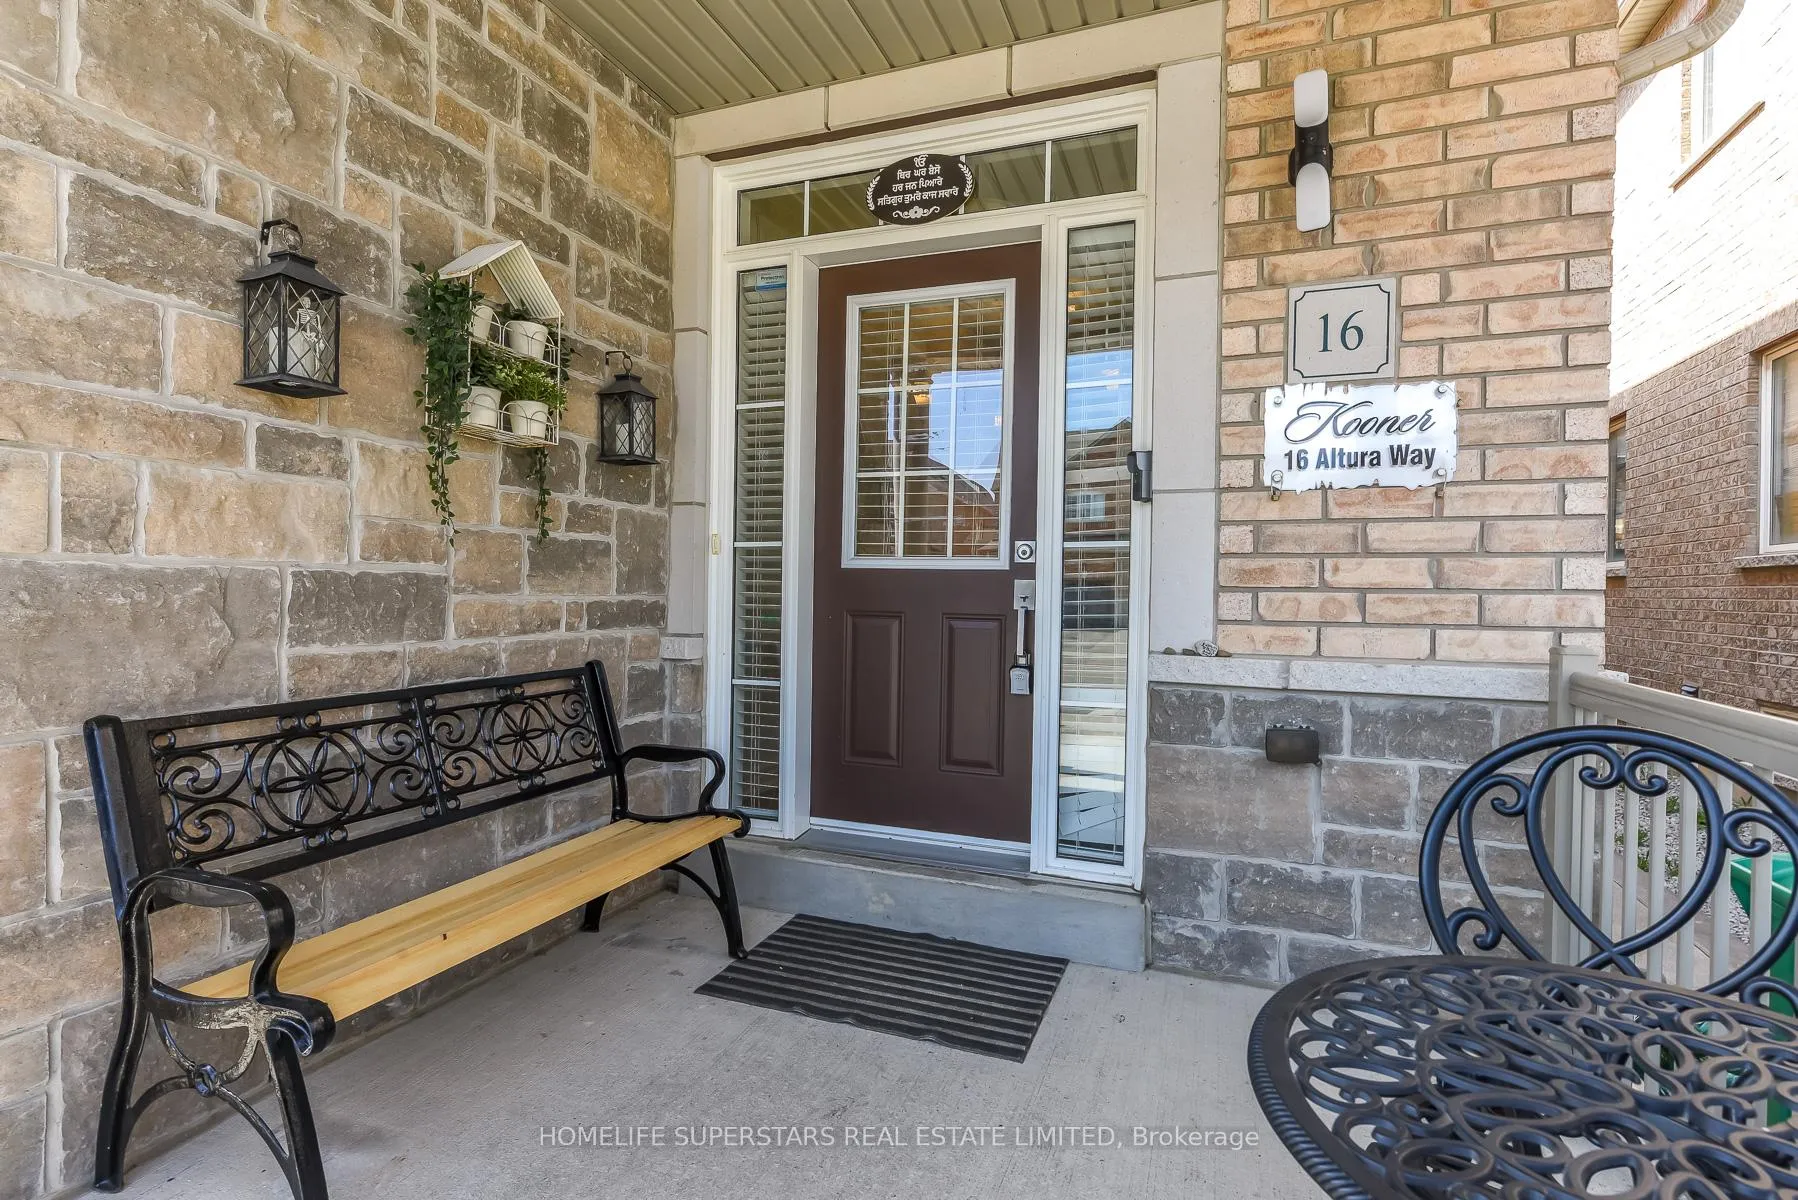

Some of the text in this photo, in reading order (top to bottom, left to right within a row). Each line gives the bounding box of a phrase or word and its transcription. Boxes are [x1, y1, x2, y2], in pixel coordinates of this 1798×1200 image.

[914, 167, 927, 177] ਘਰ
[892, 176, 943, 192] ਹਰ ਜਨ ਪਿਆਰੇ
[877, 194, 903, 206] ਸਤਿਗੁਰ
[922, 190, 938, 200] ਕਾਜ
[1318, 309, 1364, 352] 16
[1284, 400, 1436, 443] Kooner
[1284, 444, 1437, 470] 16 Altura Way
